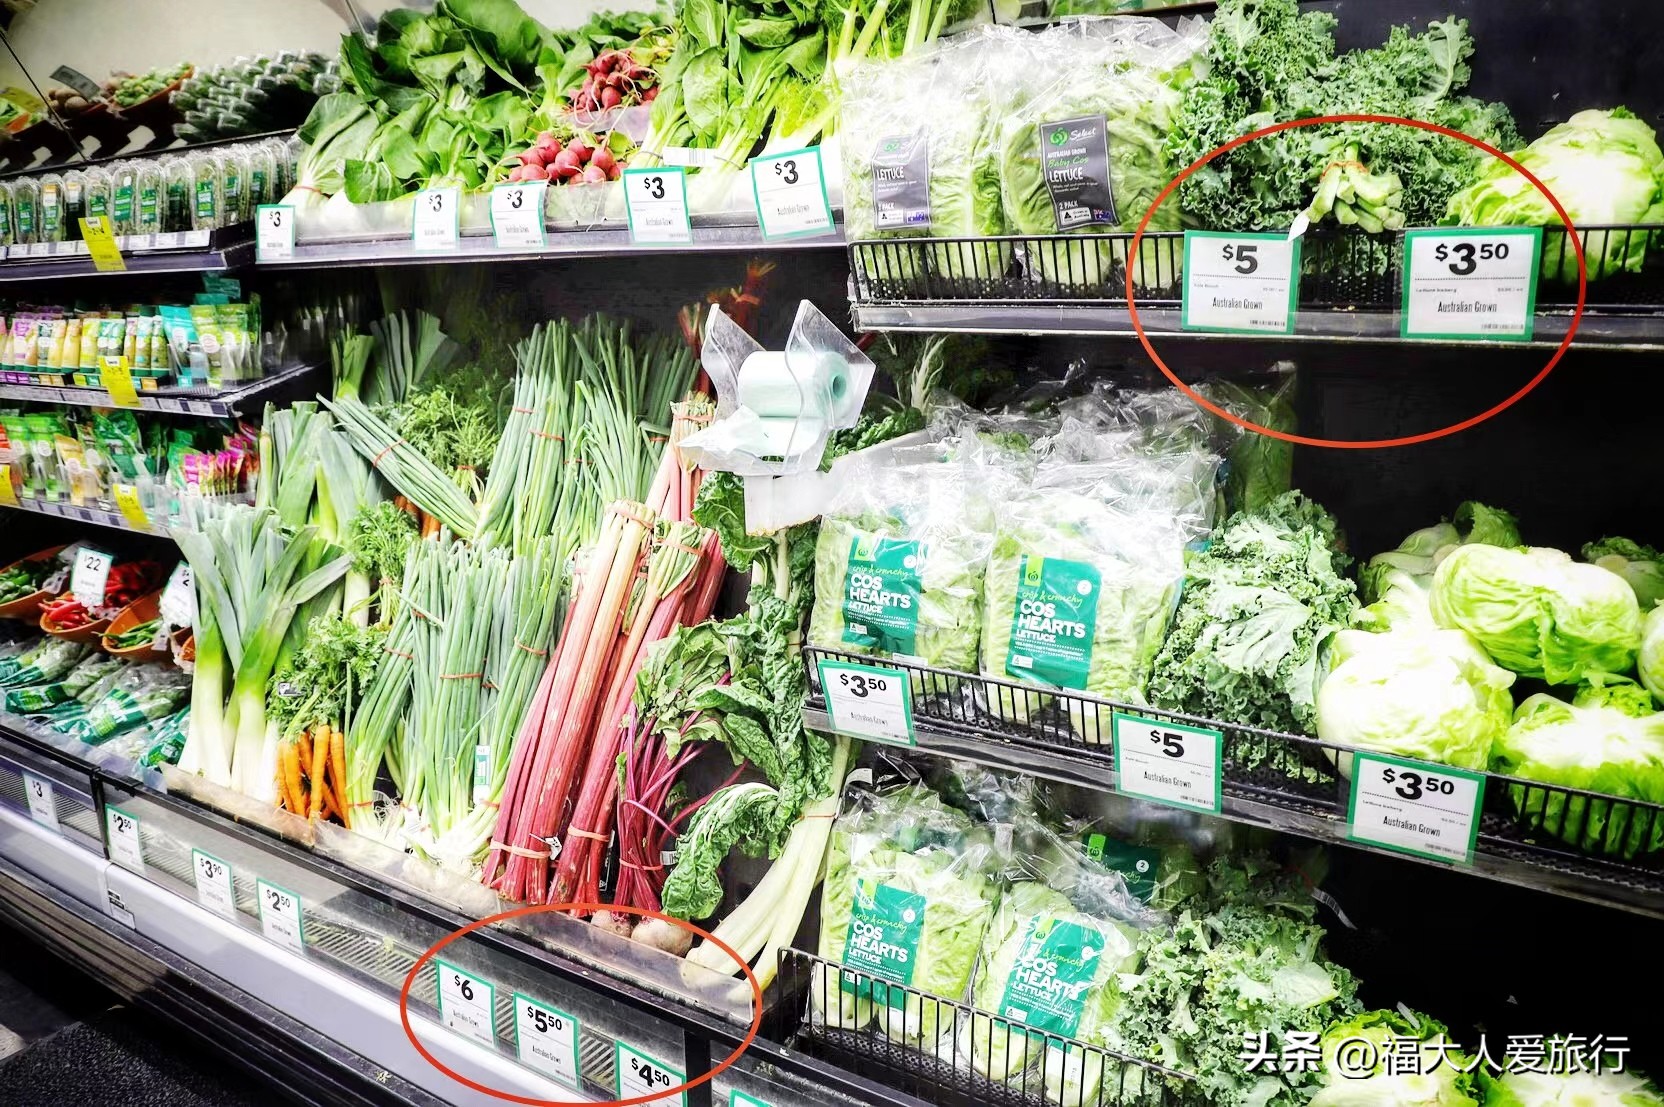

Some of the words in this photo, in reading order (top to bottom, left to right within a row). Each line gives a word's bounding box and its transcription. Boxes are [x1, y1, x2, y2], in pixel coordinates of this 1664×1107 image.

[1070, 127, 1097, 141] Select
[1048, 158, 1071, 168] Baby
[1072, 155, 1089, 165] Cos
[775, 160, 799, 184] $3
[877, 166, 905, 181] LETTUCE
[1049, 167, 1084, 182] LETTUCE
[644, 177, 665, 199] $3
[429, 194, 442, 212] $3
[507, 189, 523, 208] $3
[1064, 200, 1079, 209] PACK
[269, 211, 281, 227] $3
[1222, 243, 1258, 275] $5
[1212, 296, 1242, 309] Australian
[1243, 298, 1263, 310] Grown
[1437, 301, 1473, 313] Australian
[1474, 301, 1498, 313] Grown
[850, 573, 883, 591] COS
[848, 601, 884, 614] LETTUCE
[850, 587, 912, 609] HEARTS
[1020, 599, 1056, 618] COS
[1018, 614, 1086, 638] HEARTS
[1016, 629, 1056, 643] LETTUCE
[1150, 729, 1185, 758] $5
[1143, 770, 1172, 785] Australian
[1173, 777, 1192, 788] Grown
[1383, 815, 1417, 831] Australian
[1418, 823, 1441, 837] Grown
[853, 920, 883, 940] COS
[848, 947, 882, 964] LETTUCE
[850, 932, 908, 963] HEARTS
[1021, 957, 1058, 977] COS
[454, 975, 474, 1001] $6
[1012, 981, 1054, 1001] LETTUCE
[1016, 967, 1079, 1000] HEARTS
